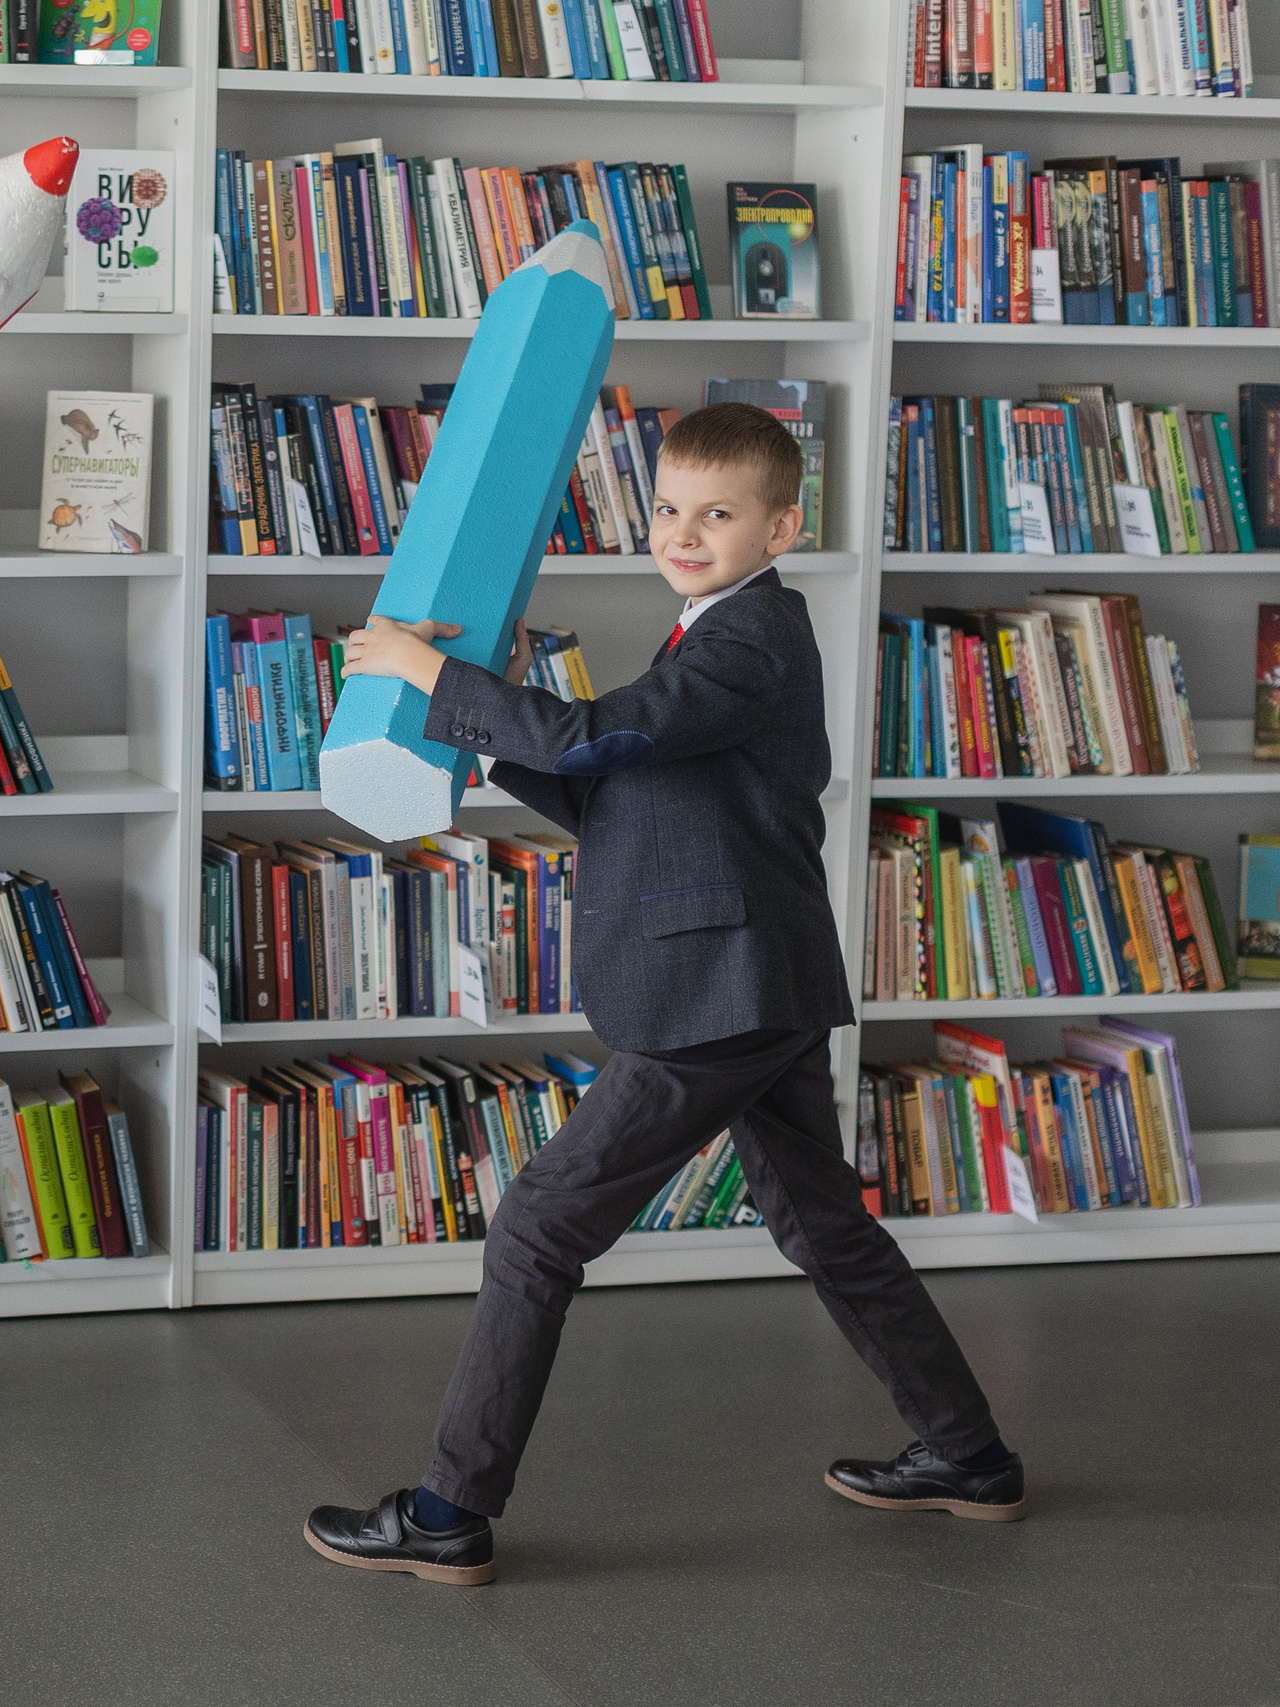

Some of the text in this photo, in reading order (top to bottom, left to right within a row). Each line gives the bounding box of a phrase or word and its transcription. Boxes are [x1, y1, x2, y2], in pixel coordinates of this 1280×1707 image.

[926, 0, 941, 62] Intern
[1178, 10, 1190, 69] СПЕЦИАЛЬНАЯ
[99, 174, 134, 203] ВИ
[119, 208, 151, 237] РУ
[278, 169, 296, 240] СКЛАД
[98, 240, 139, 269] СЫ
[343, 174, 364, 301] Коммерческое товароведение
[447, 192, 470, 267] КВАЛИМЕТРИЯ
[1013, 221, 1023, 296] Windows XP
[52, 455, 139, 477] СУПЕРНАВИГАТОРЫ
[249, 441, 270, 534] СПРАВОЧНИК ЭЛЕКТРИКА
[215, 686, 231, 751] ИНФОРМАТИКА
[250, 686, 268, 784] ОСНОВЫ ИНФОРМАТИКИ
[270, 662, 289, 753] ИНФОРМАТИКА
[295, 647, 319, 783] ПРАКТИКУМ ПО ИНФОРМАТИКЕ
[17, 720, 42, 771] БИОФИЗИКА
[253, 859, 264, 941] ЭЛЕКТРОННЫЕ СХЕМЫ
[311, 879, 325, 1009] МАТЕРИАЛЫ ЭЛЕКТРОННОЙ ТЕХНИКИ
[92, 1133, 112, 1217] Физиология человека
[116, 1128, 143, 1246] Анатомия физиология человека
